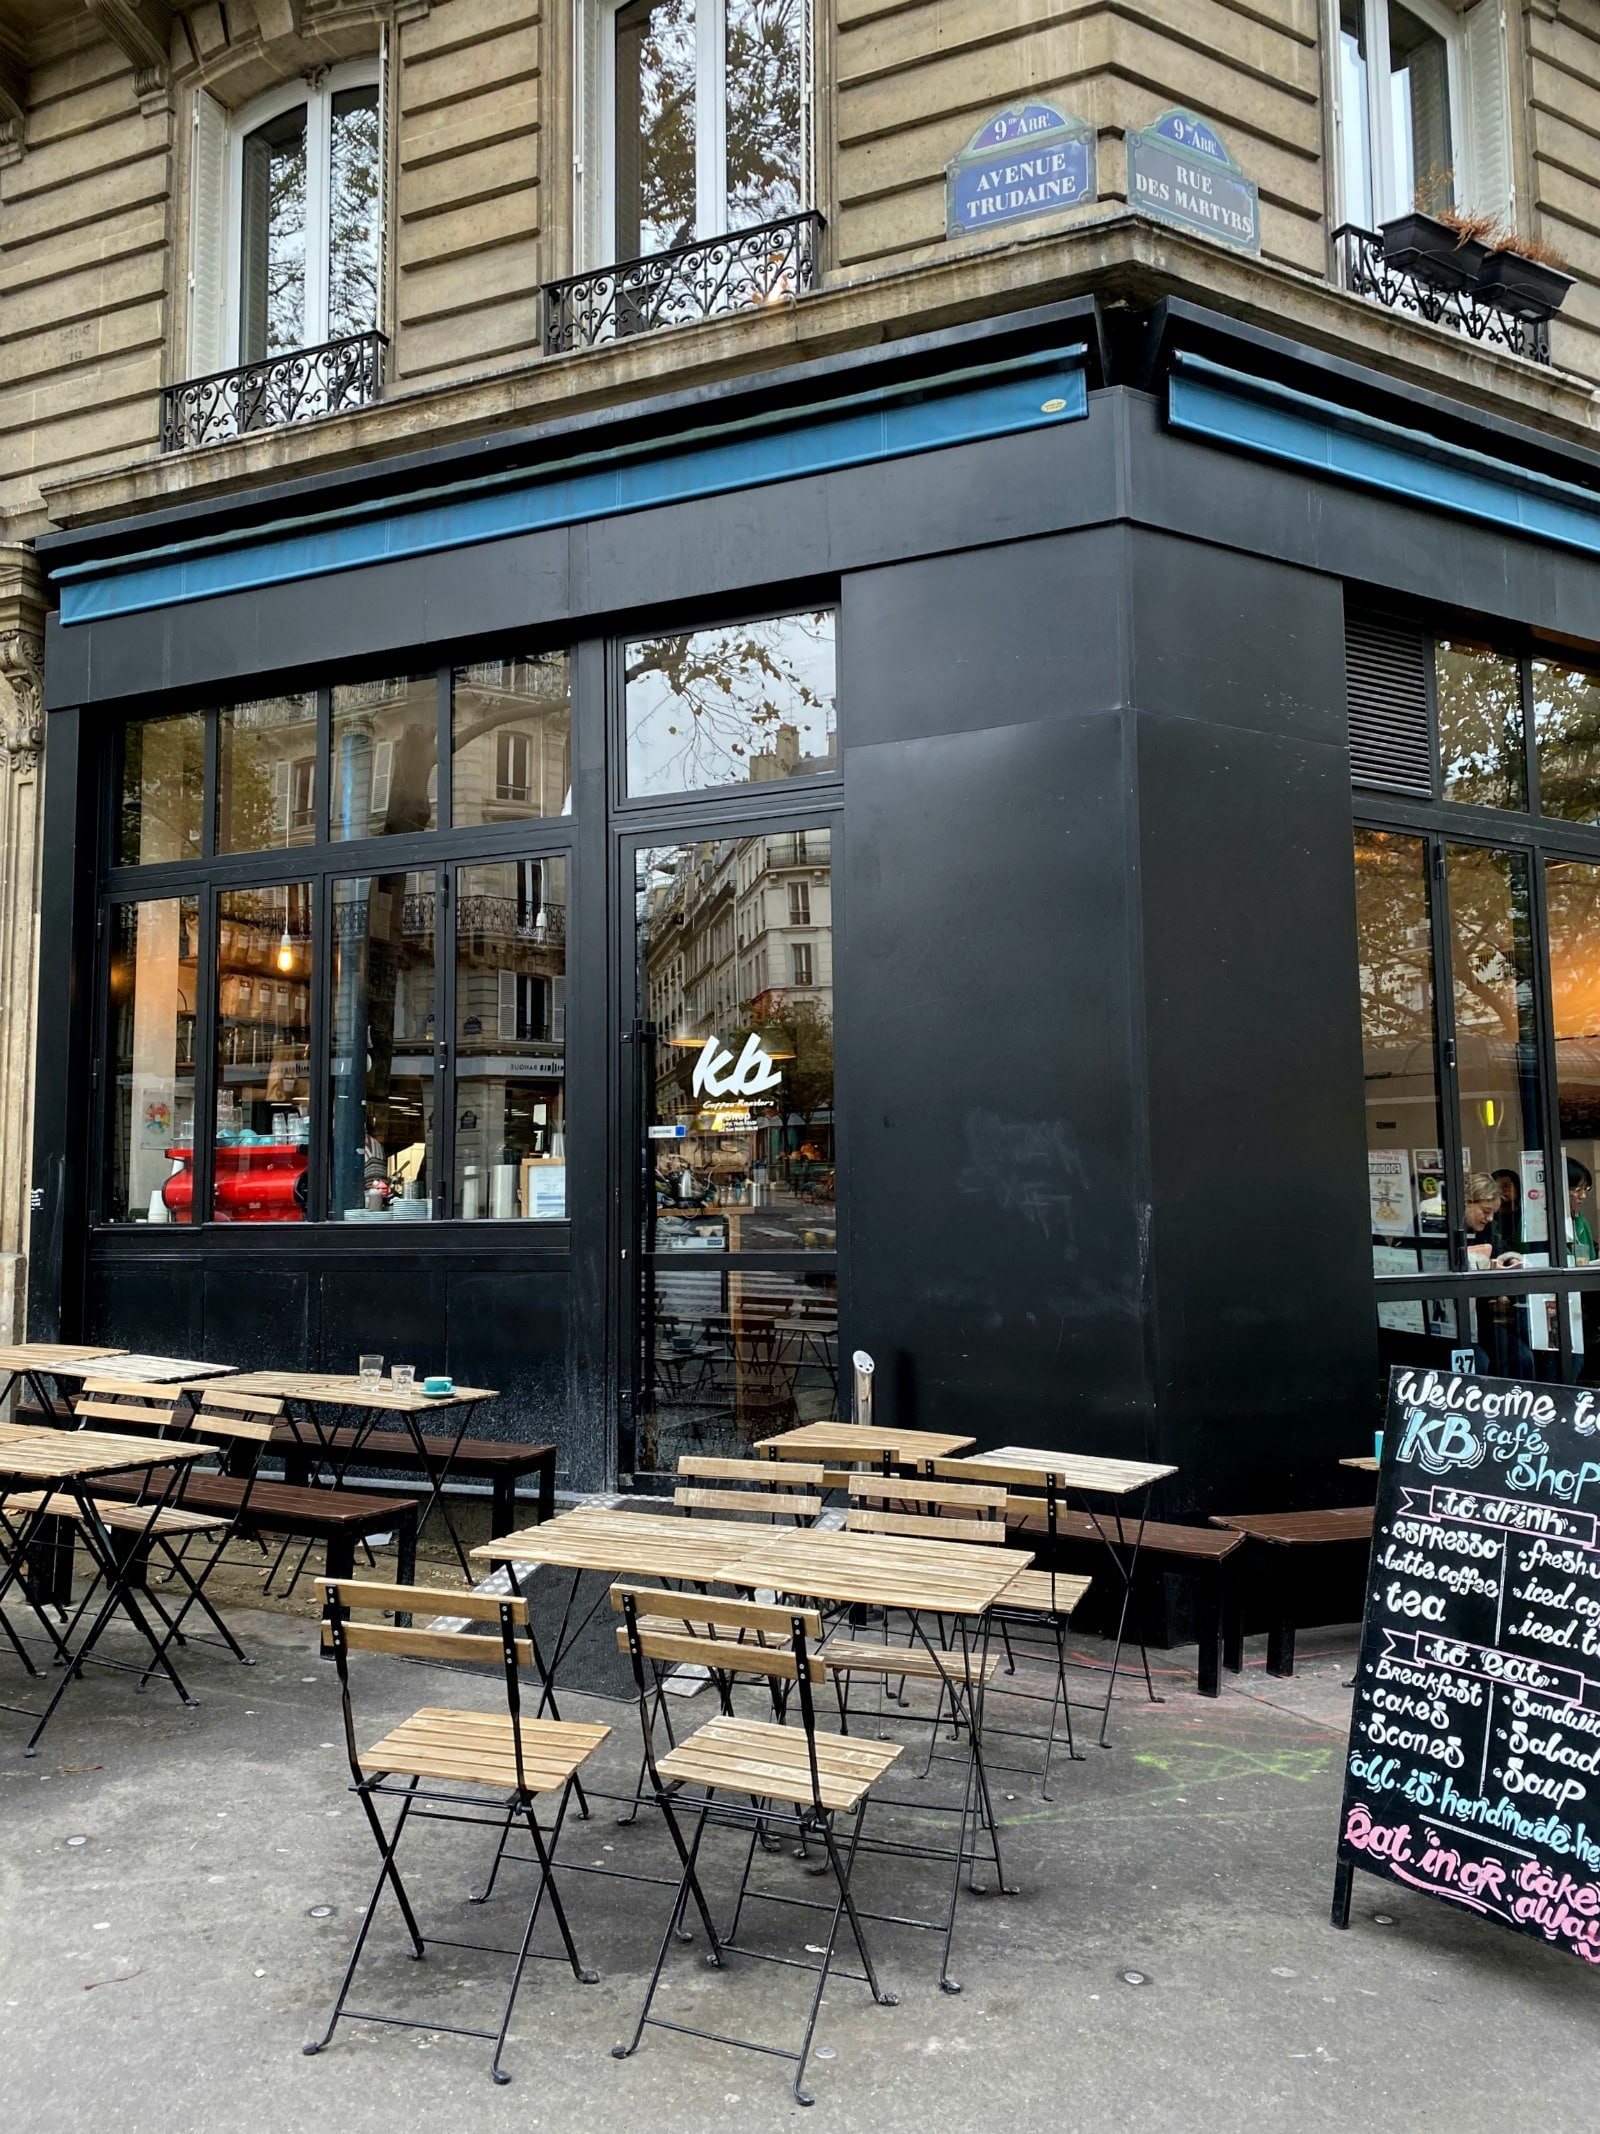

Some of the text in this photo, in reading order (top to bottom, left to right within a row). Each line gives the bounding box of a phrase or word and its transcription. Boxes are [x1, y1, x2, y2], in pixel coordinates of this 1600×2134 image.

[976, 152, 1066, 193] AVENUE
[1176, 165, 1213, 195] RUE
[966, 175, 1076, 219] TRUDAINE
[1136, 172, 1253, 234] DES MARTYRS
[1455, 1354, 1474, 1374] 37
[1397, 1371, 1557, 1421] Welcome
[1400, 1410, 1543, 1463] KB café
[1387, 1581, 1447, 1622] tea
[1482, 1651, 1542, 1687] eat
[1502, 1756, 1587, 1811] Soup
[1440, 1777, 1570, 1854] handmade
[1344, 1811, 1412, 1861] eat
[1420, 1836, 1458, 1883] in
[1520, 1860, 1600, 1916] take
